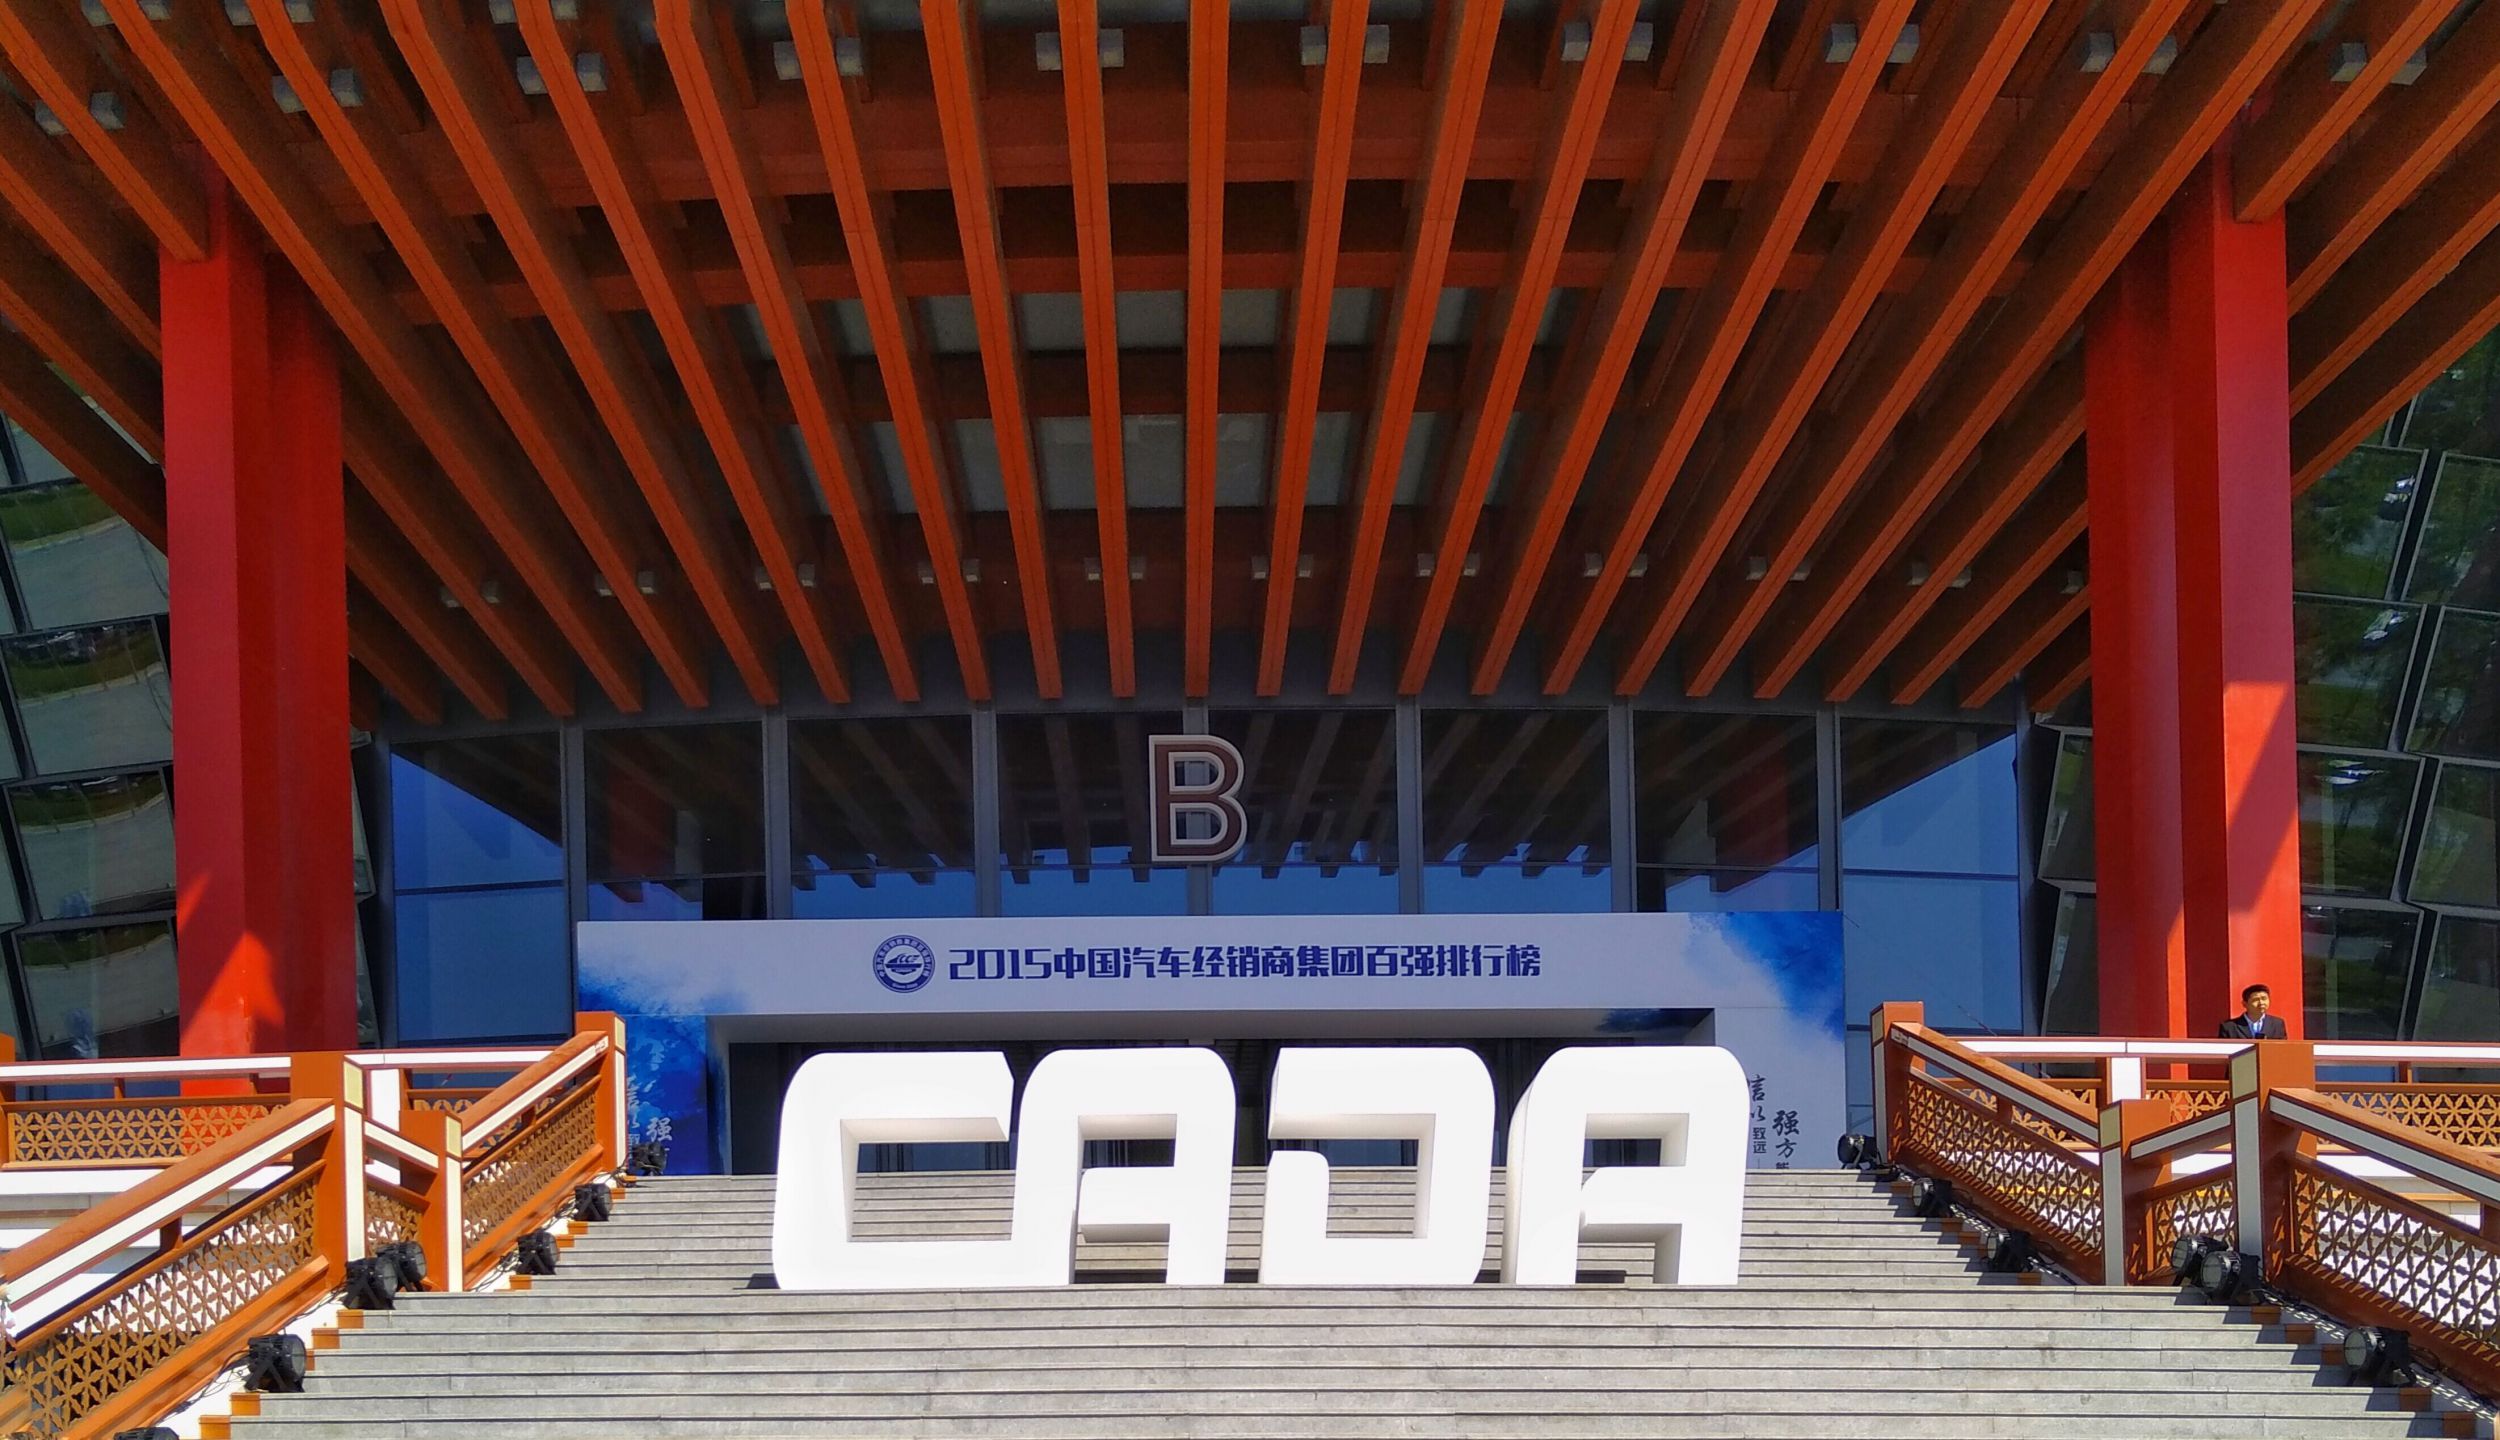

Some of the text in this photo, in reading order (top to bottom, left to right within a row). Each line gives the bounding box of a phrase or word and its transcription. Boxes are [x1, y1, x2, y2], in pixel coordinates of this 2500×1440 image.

[1149, 735, 1248, 862] B
[949, 944, 1541, 980] 2015中国汽车经销商集团百强排行榜
[772, 1046, 1750, 1289] CADA
